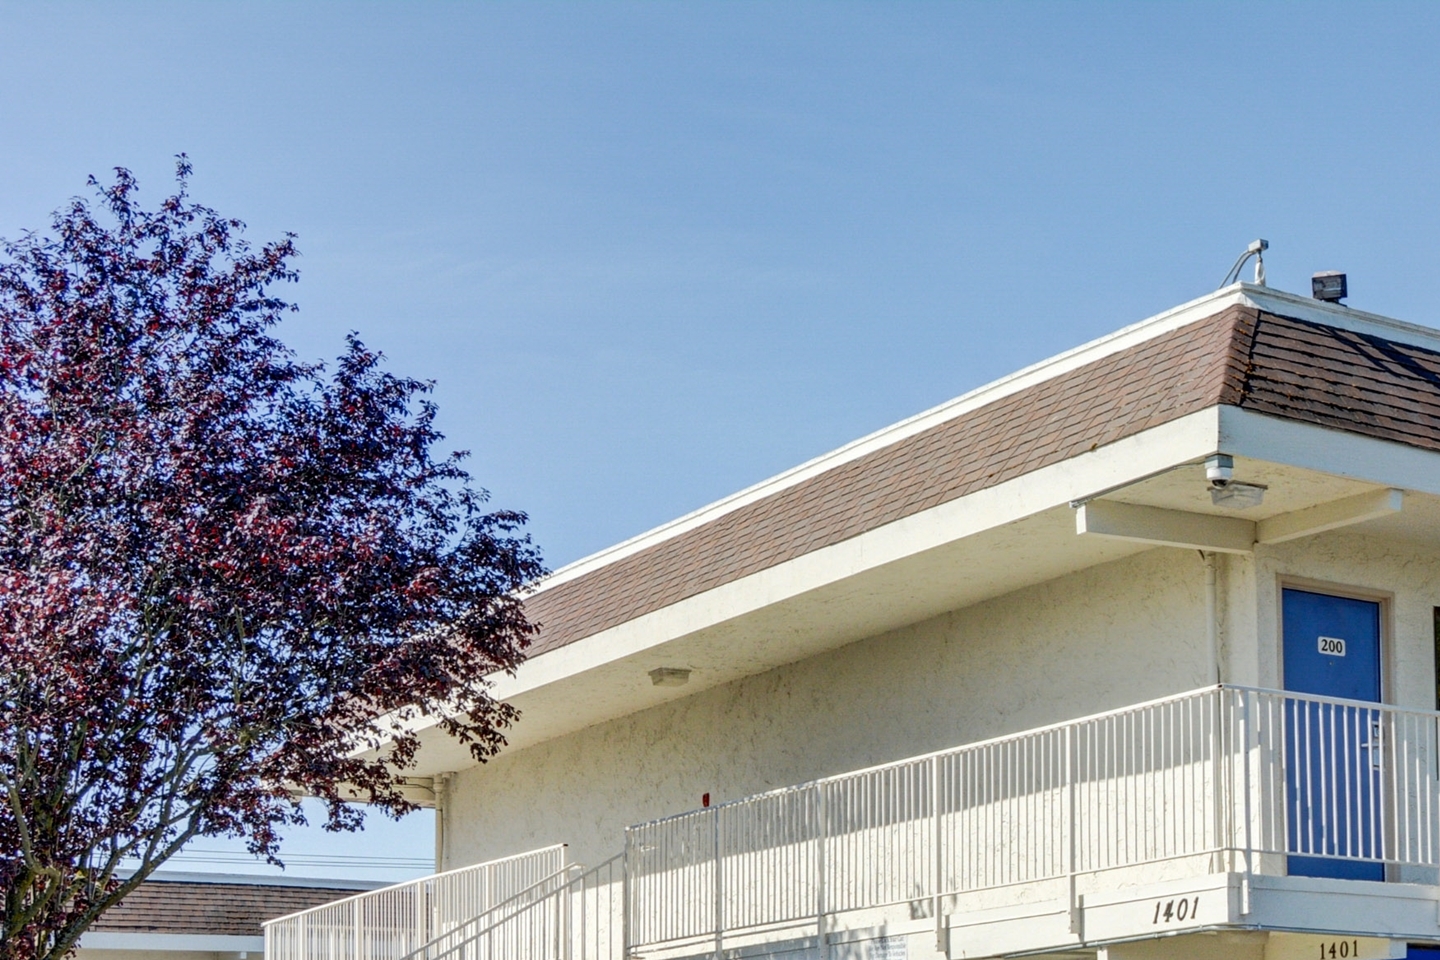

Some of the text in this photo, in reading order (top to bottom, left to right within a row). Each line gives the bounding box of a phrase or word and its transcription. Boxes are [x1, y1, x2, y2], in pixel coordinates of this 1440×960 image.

[1321, 639, 1343, 653] 200
[1152, 897, 1199, 924] 1401
[1320, 940, 1358, 960] 1401
